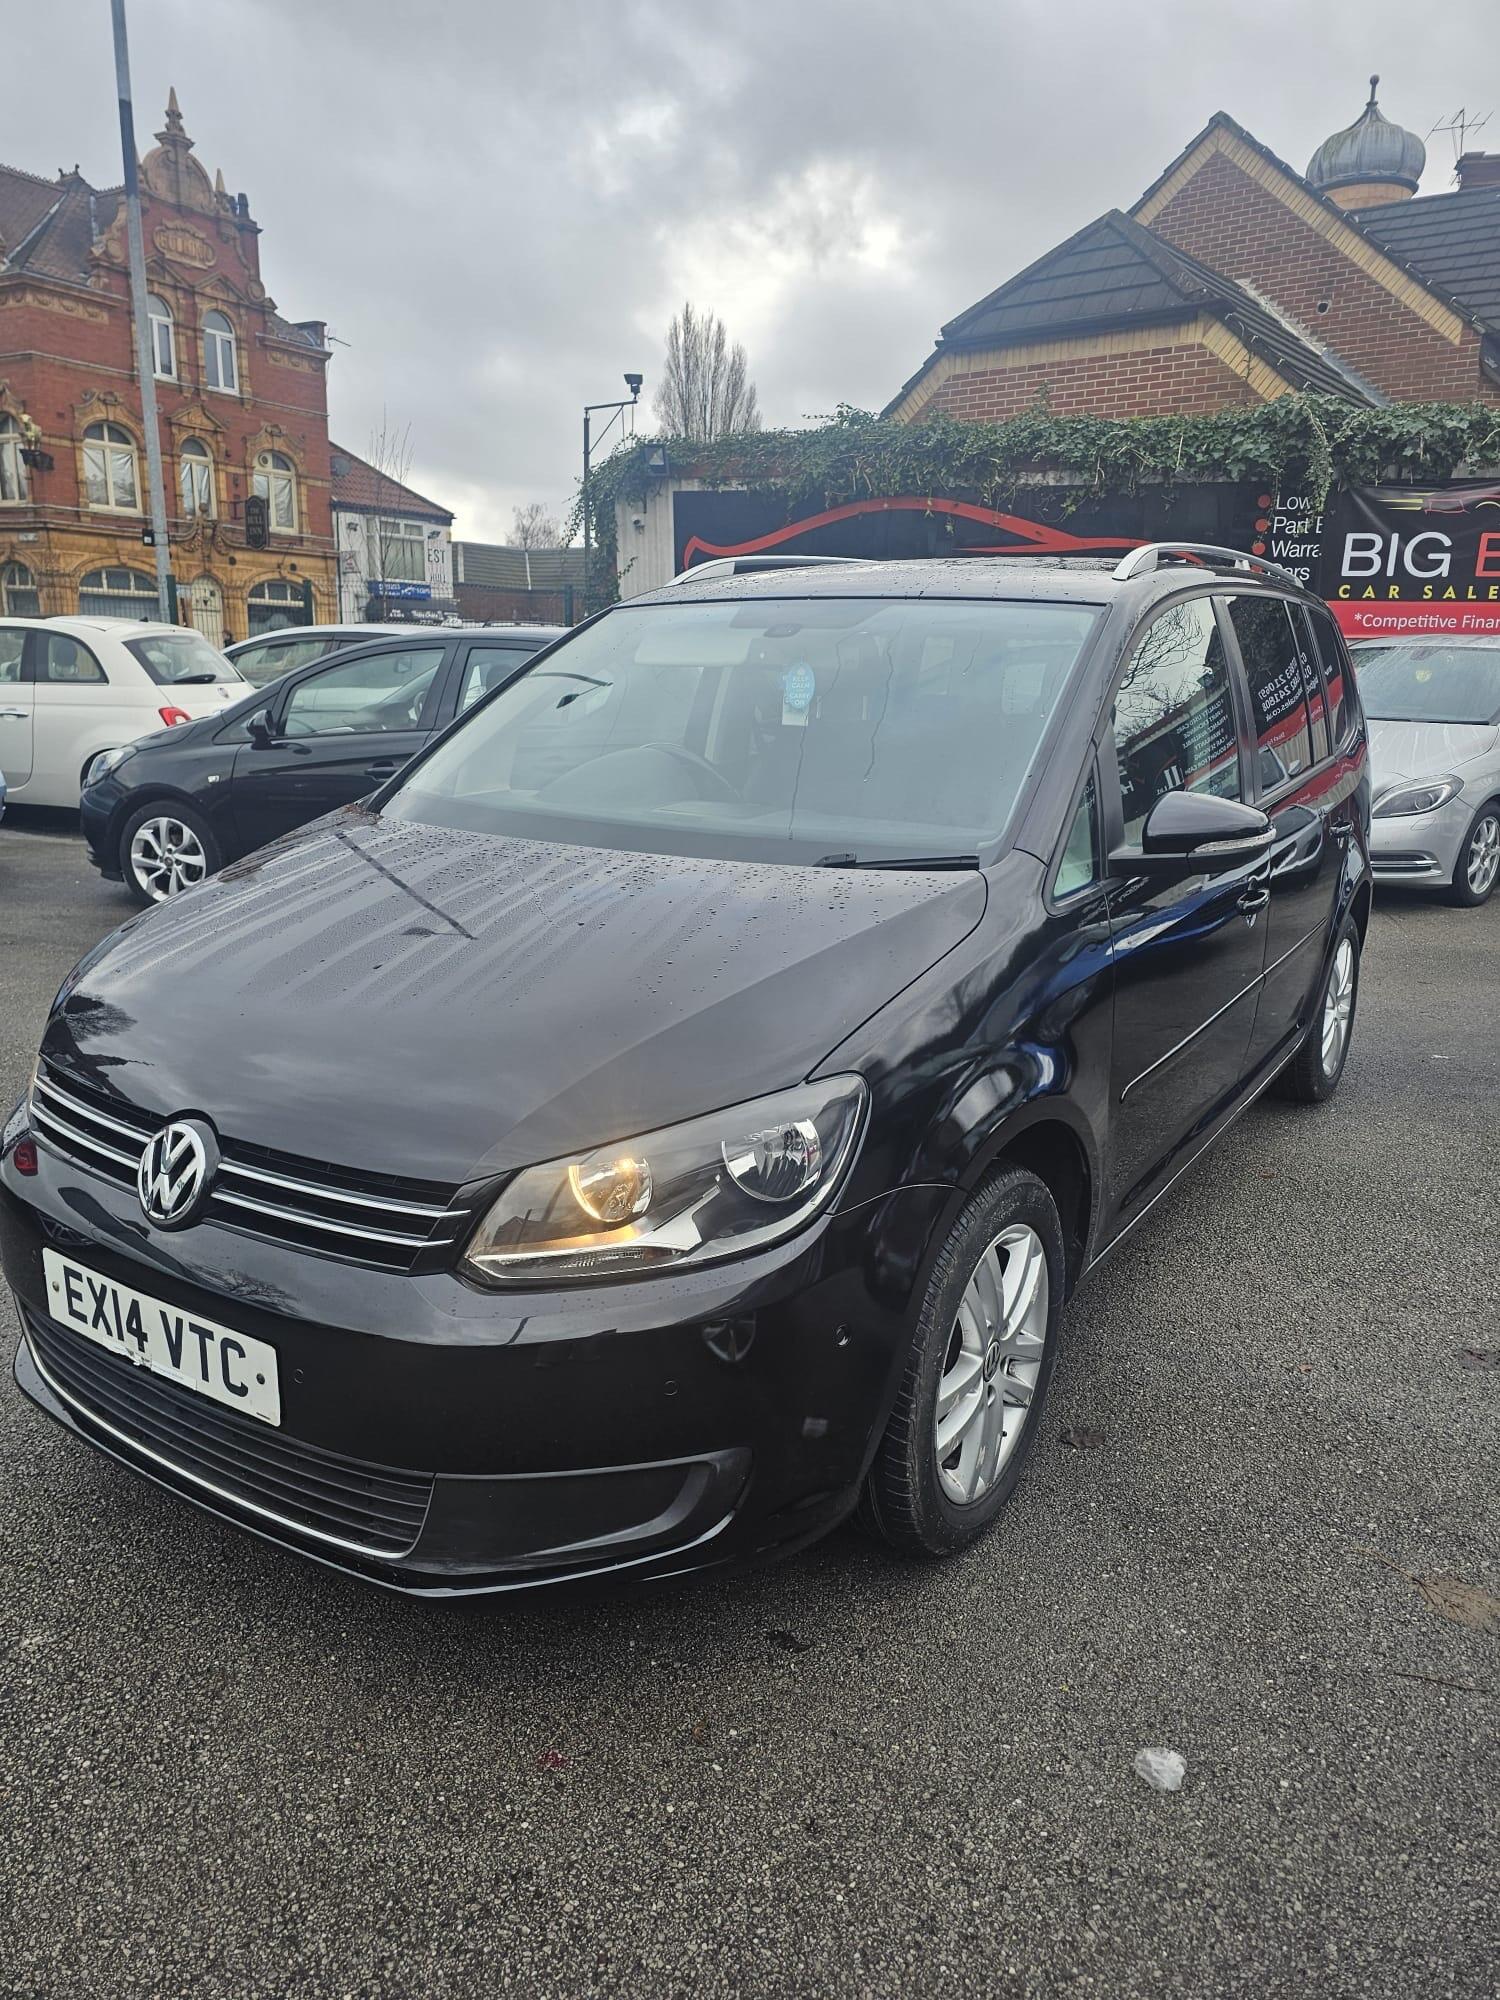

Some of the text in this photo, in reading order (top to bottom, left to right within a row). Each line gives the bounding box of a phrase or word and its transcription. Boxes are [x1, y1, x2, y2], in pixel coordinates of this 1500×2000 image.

[1272, 516, 1309, 534] Part
[1341, 532, 1453, 578] BIG
[1338, 584, 1500, 600] CAR SALE
[63, 1264, 249, 1398] EX14 VTC
